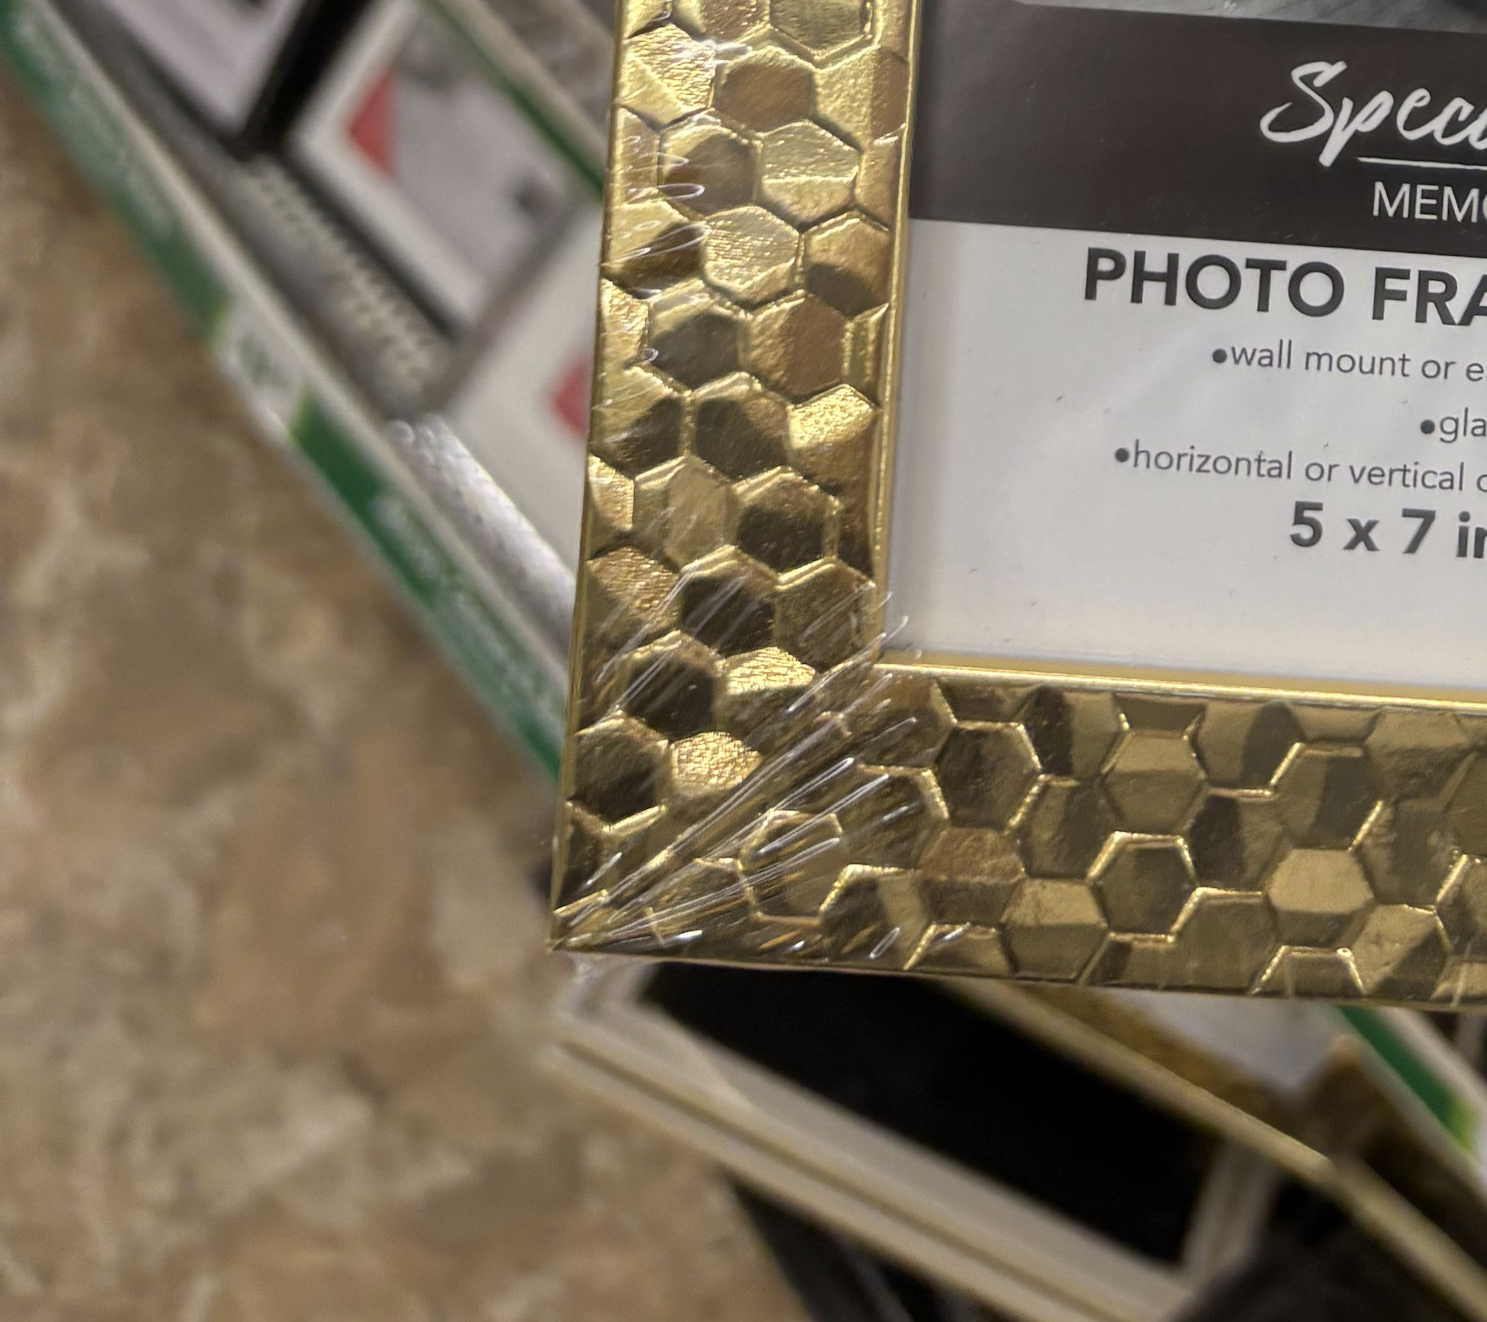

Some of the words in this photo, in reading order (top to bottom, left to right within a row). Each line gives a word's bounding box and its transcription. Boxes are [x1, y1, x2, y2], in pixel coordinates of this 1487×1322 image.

[1083, 246, 1345, 319] PHOTO
[1230, 338, 1293, 370] wall
[1304, 351, 1412, 378] mount
[1420, 359, 1457, 381] or
[1132, 438, 1293, 480] horizontal
[1304, 462, 1341, 483] or
[1348, 461, 1465, 492] vertical
[1289, 500, 1324, 549] 5
[1342, 518, 1380, 553] x
[1401, 507, 1437, 555] 7
